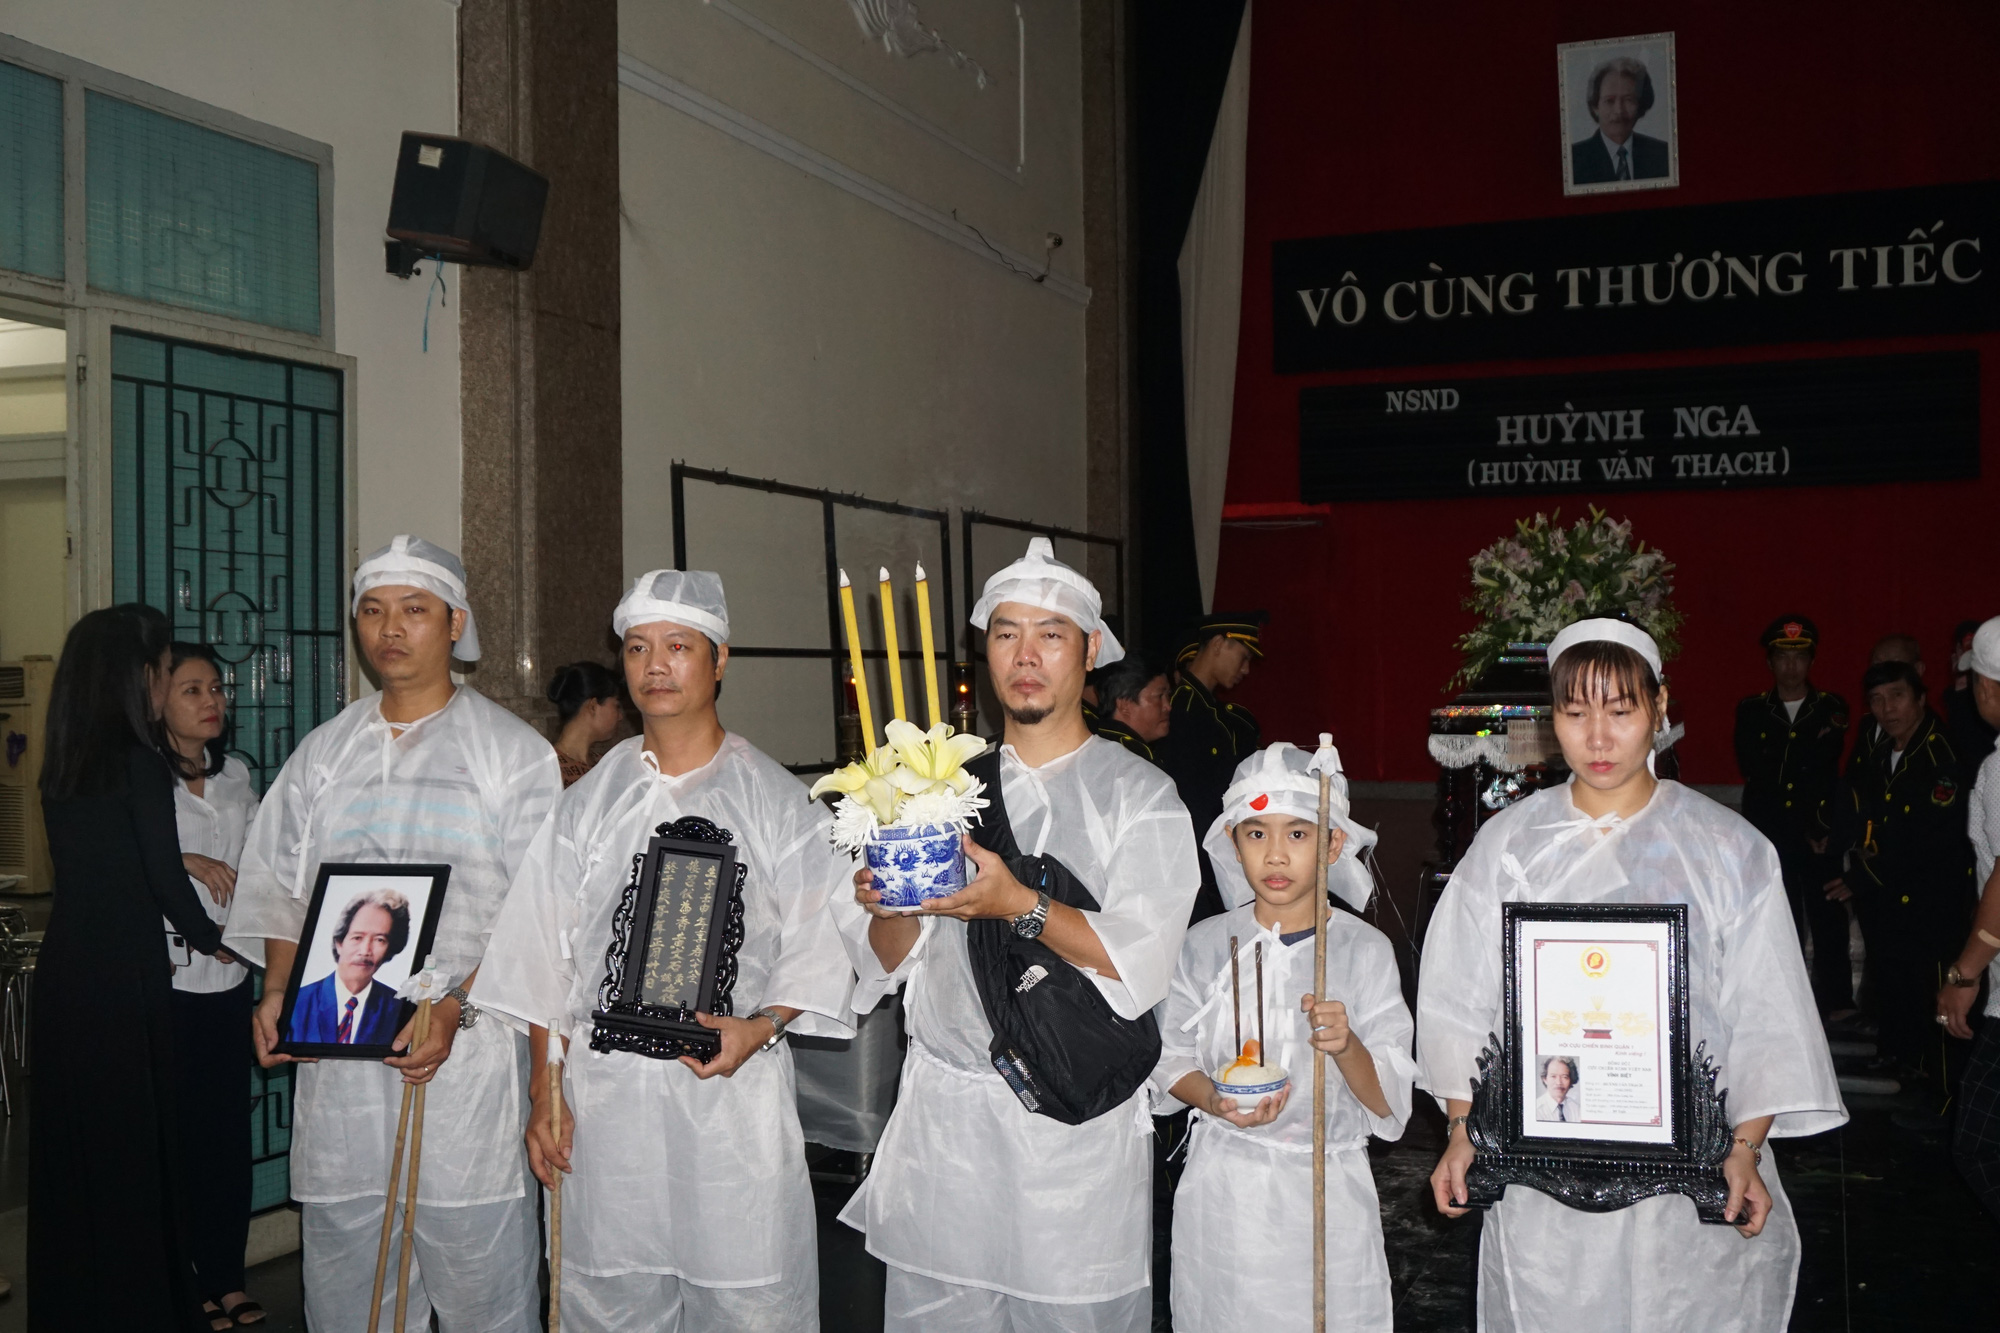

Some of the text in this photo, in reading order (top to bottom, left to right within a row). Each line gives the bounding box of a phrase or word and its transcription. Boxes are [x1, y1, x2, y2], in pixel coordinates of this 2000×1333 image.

[1297, 220, 1983, 327] VÔ CÙNG THƯƠNG TIẾC
[1385, 388, 1460, 413] NSND
[1497, 402, 1761, 445] HUỲNH NGA
[1467, 446, 1790, 488] (HUỲNH VĂN THẠCH)
